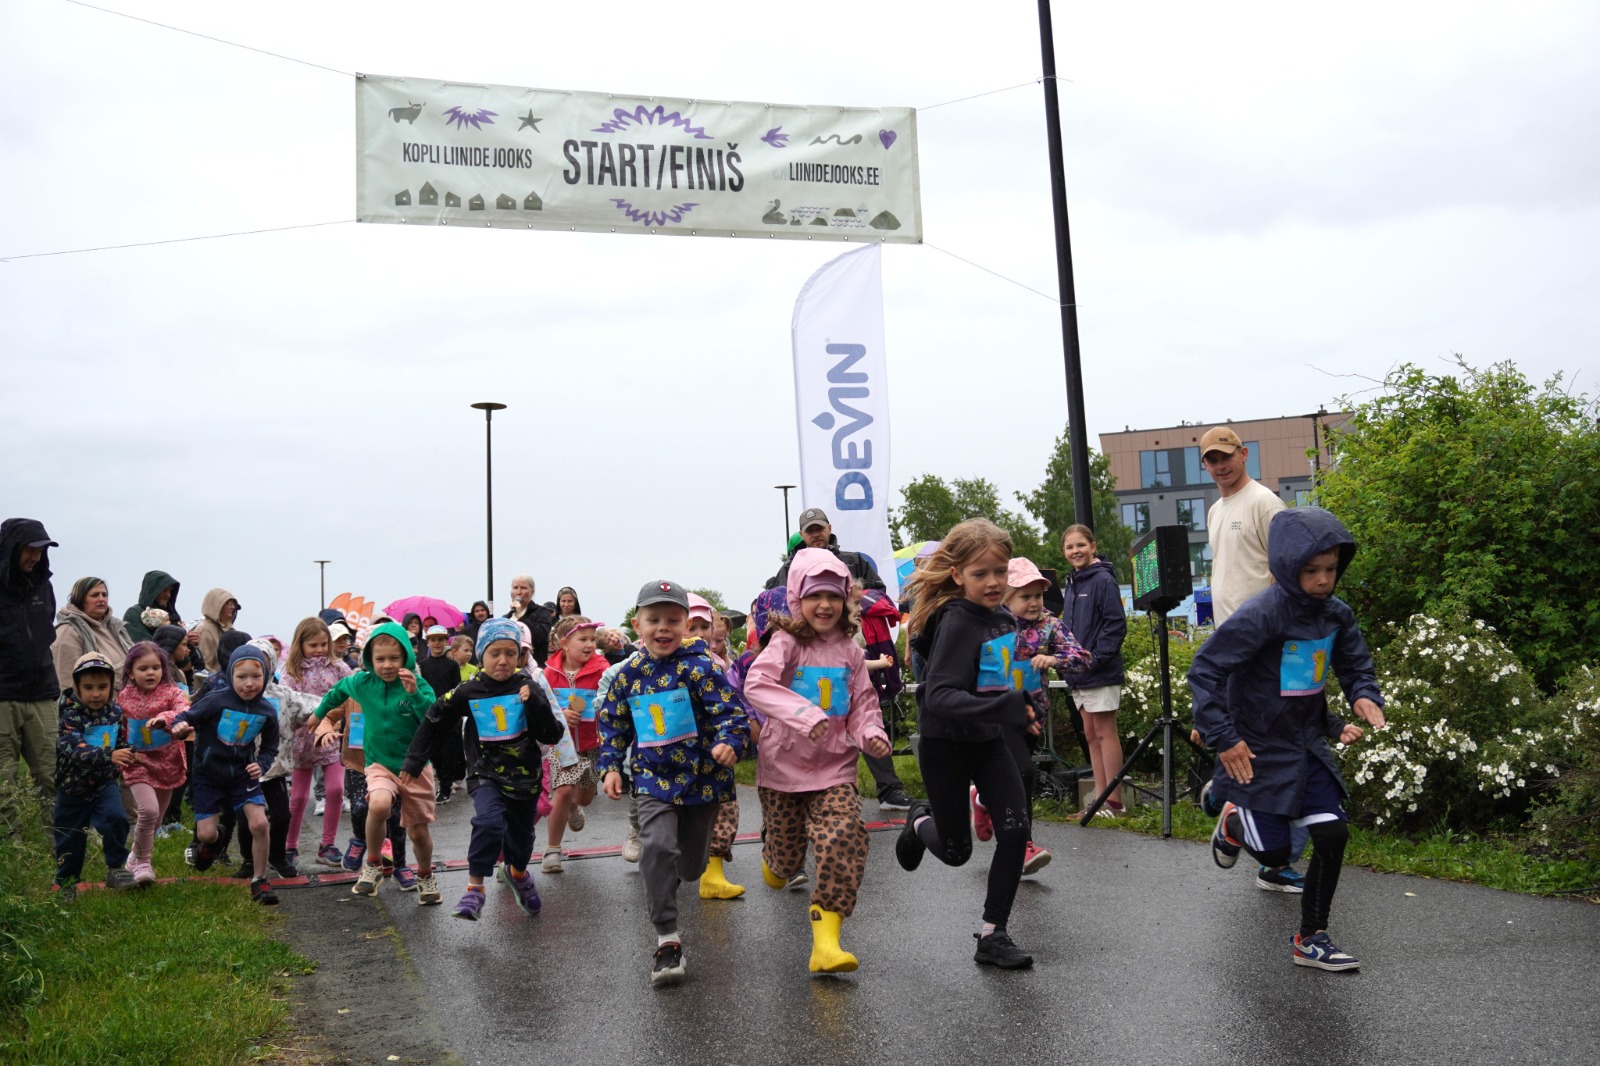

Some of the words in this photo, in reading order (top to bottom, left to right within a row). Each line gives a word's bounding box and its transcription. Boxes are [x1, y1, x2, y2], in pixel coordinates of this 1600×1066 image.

[403, 142, 440, 164] KOPLI
[444, 146, 490, 167] LIINIDE
[493, 148, 533, 169] JOOKS
[563, 139, 744, 192] START/FINIŠ
[789, 162, 880, 185] LIINIDEJOOKS.EE
[824, 343, 874, 511] DEVIN
[1312, 649, 1326, 683] 1
[817, 677, 832, 711] 1
[236, 720, 248, 740] 1
[492, 705, 507, 732] 1
[649, 704, 666, 736] 1
